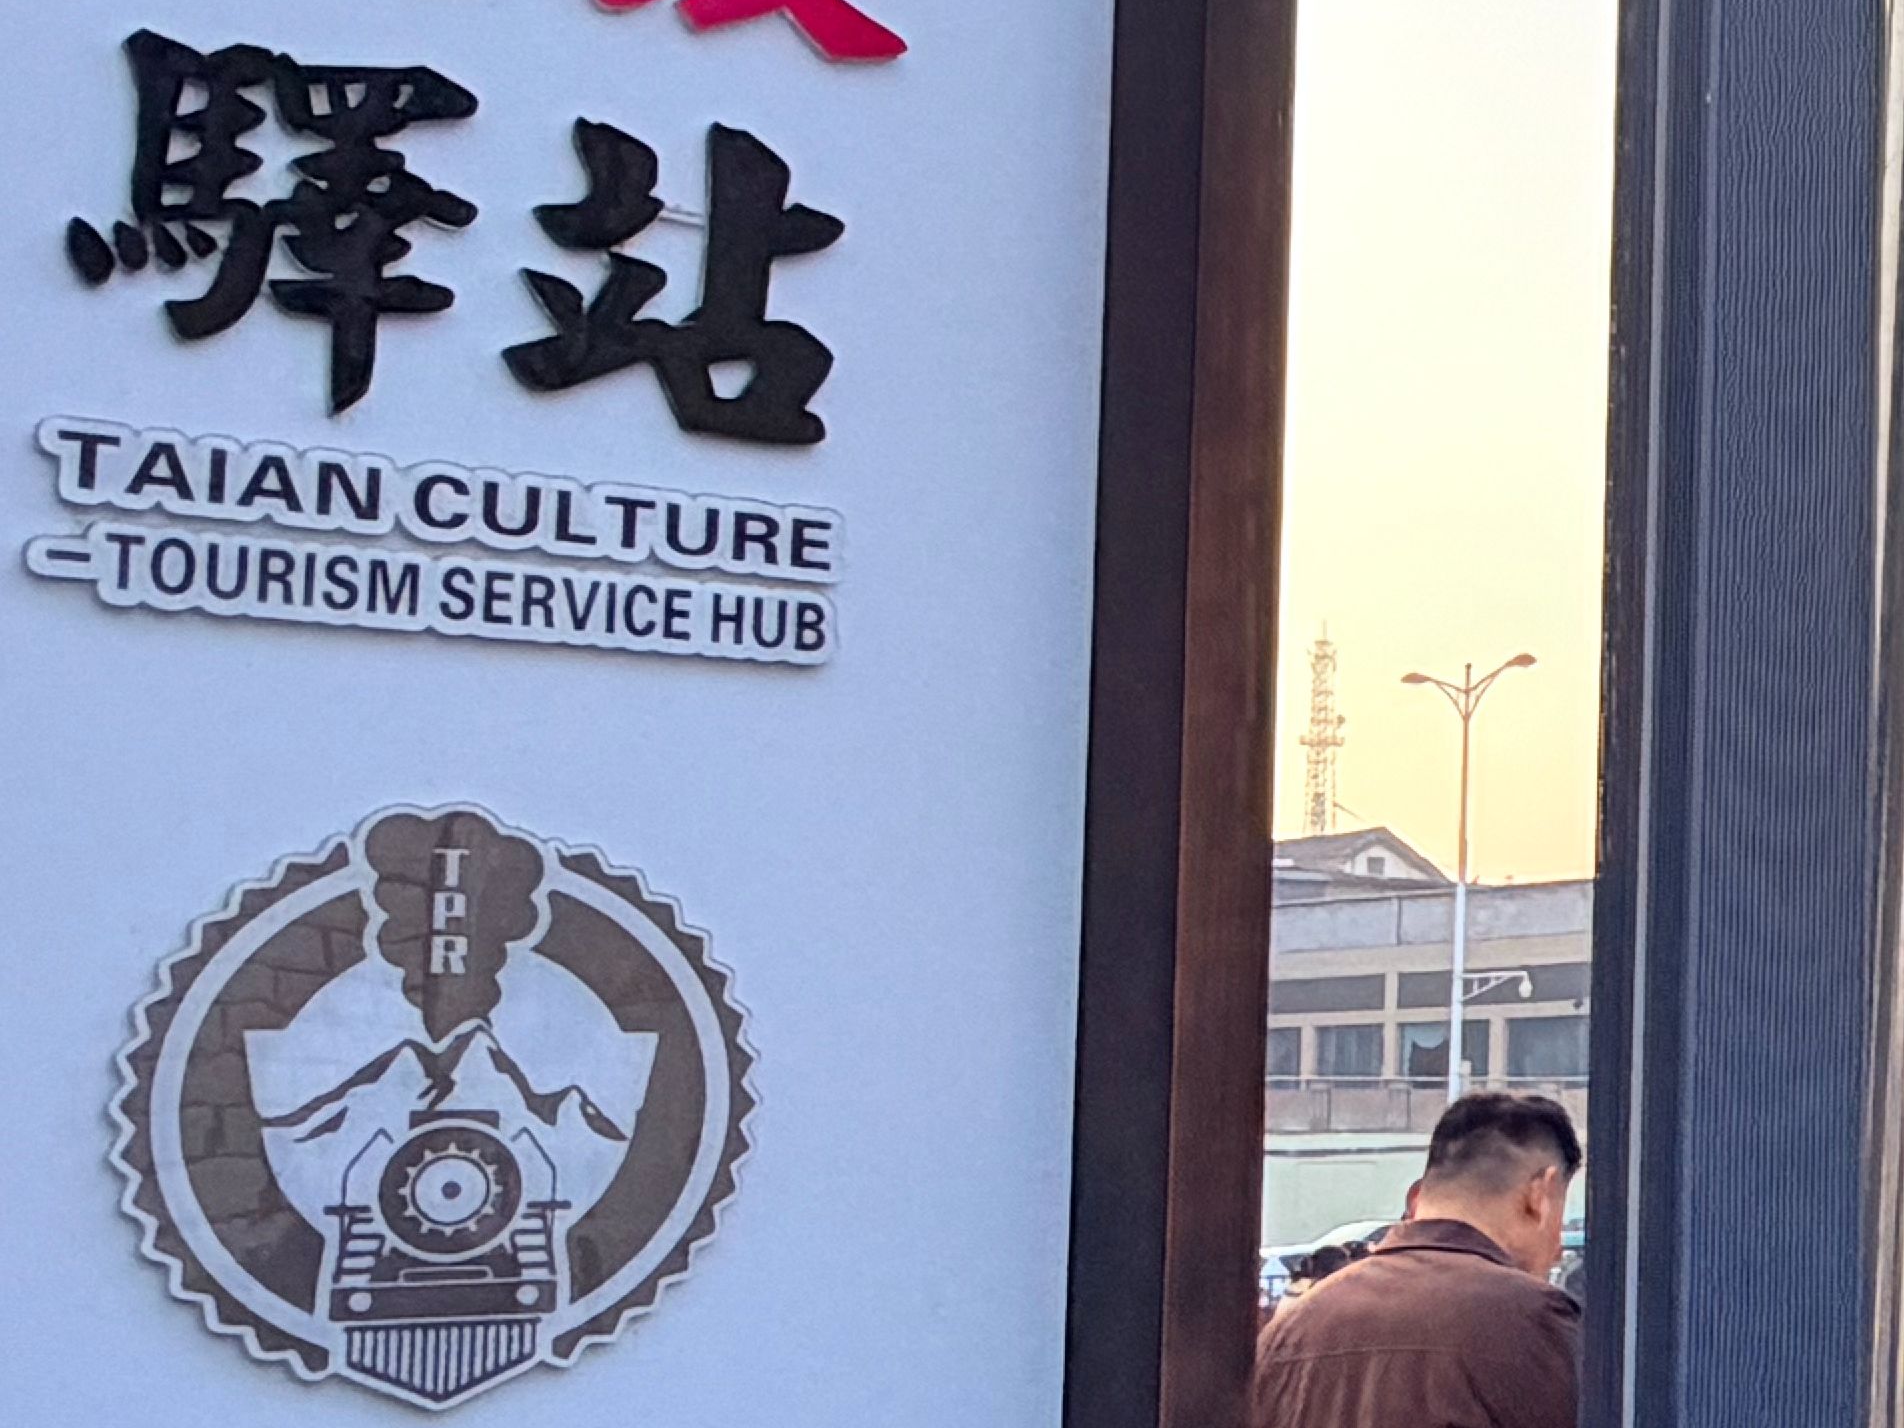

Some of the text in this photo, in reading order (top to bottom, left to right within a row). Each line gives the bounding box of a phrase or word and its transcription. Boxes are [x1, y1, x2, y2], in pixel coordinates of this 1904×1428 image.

[58, 429, 835, 572] TAIAN CULTURE
[439, 570, 692, 642] SERVICE
[709, 593, 828, 655] HUB
[430, 848, 470, 974] TPR
